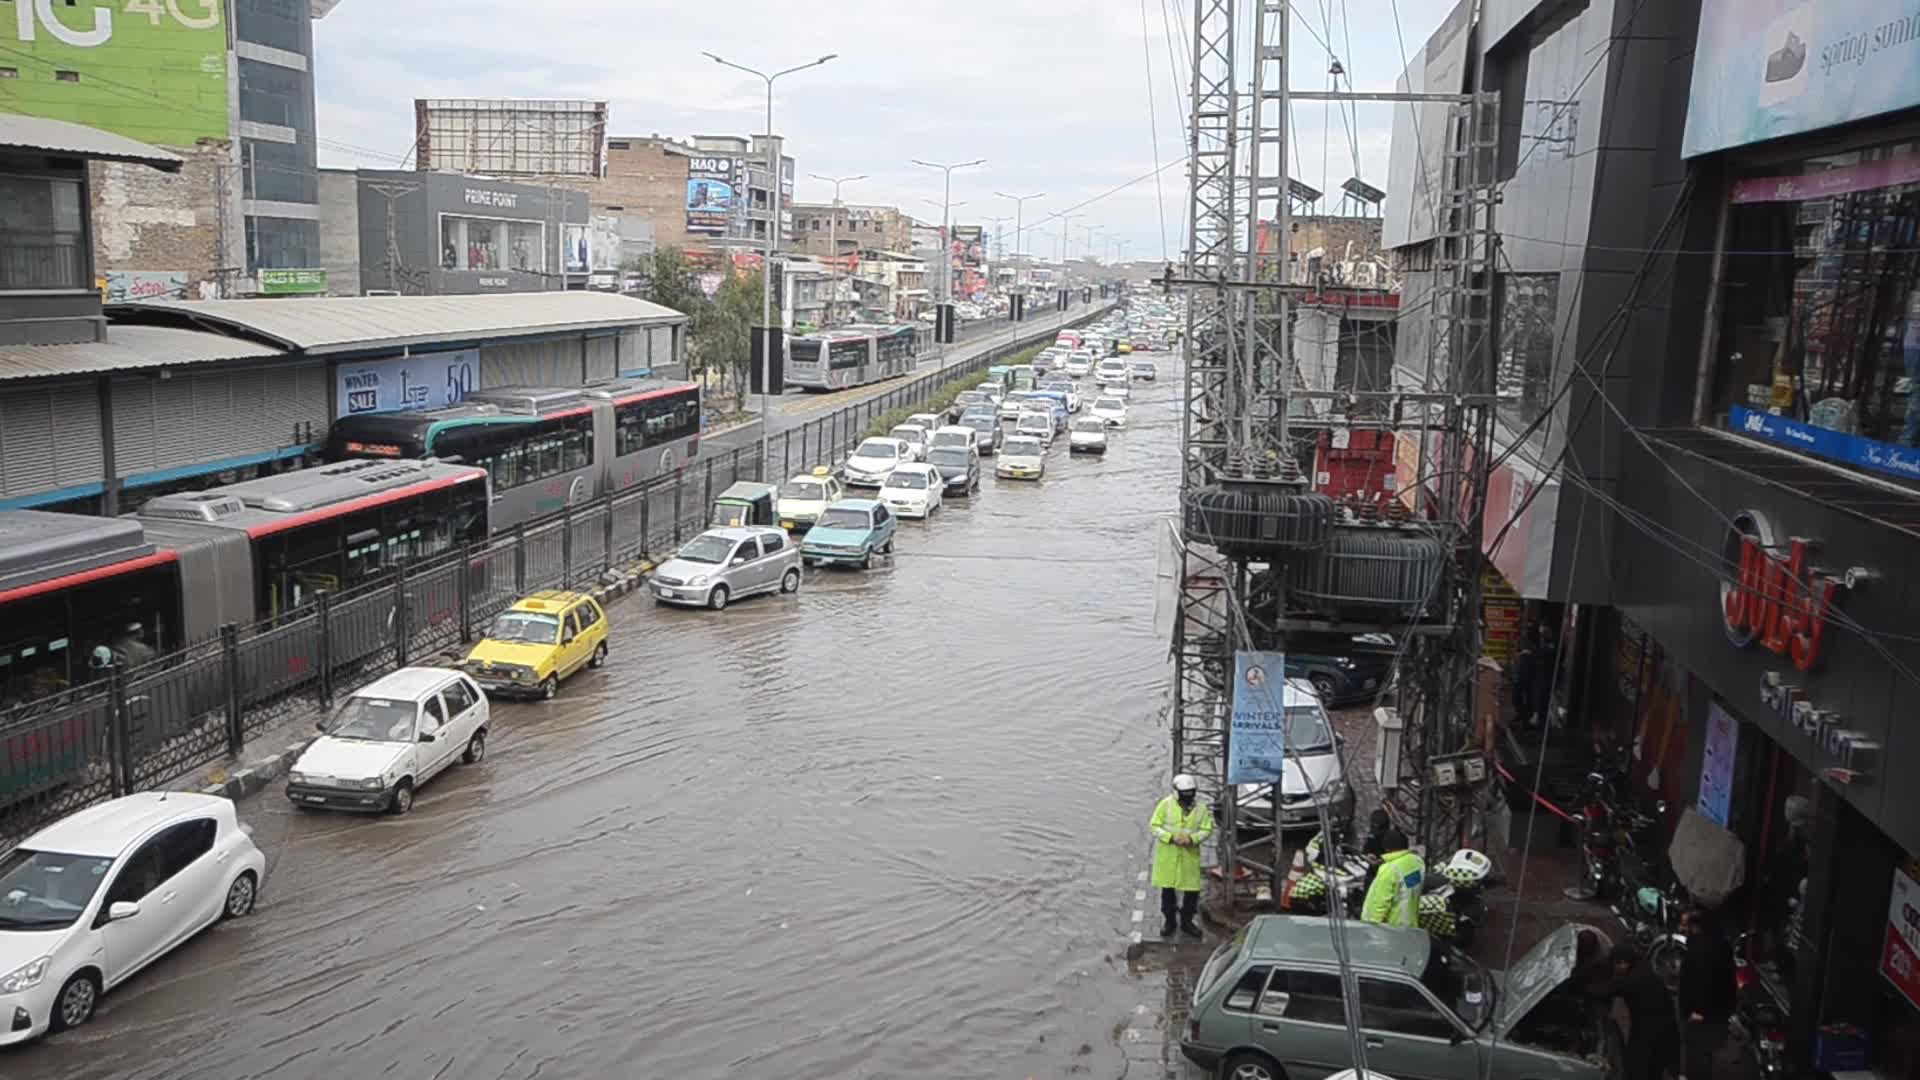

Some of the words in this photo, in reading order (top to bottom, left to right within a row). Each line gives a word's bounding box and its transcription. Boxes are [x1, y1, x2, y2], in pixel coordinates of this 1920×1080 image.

[1820, 31, 1869, 76] spring
[690, 158, 717, 171] HAQ
[465, 188, 491, 205] PRIME
[492, 191, 517, 208] POINT
[345, 372, 379, 389] WINTER
[447, 362, 472, 404] 50
[350, 392, 376, 410] SALE
